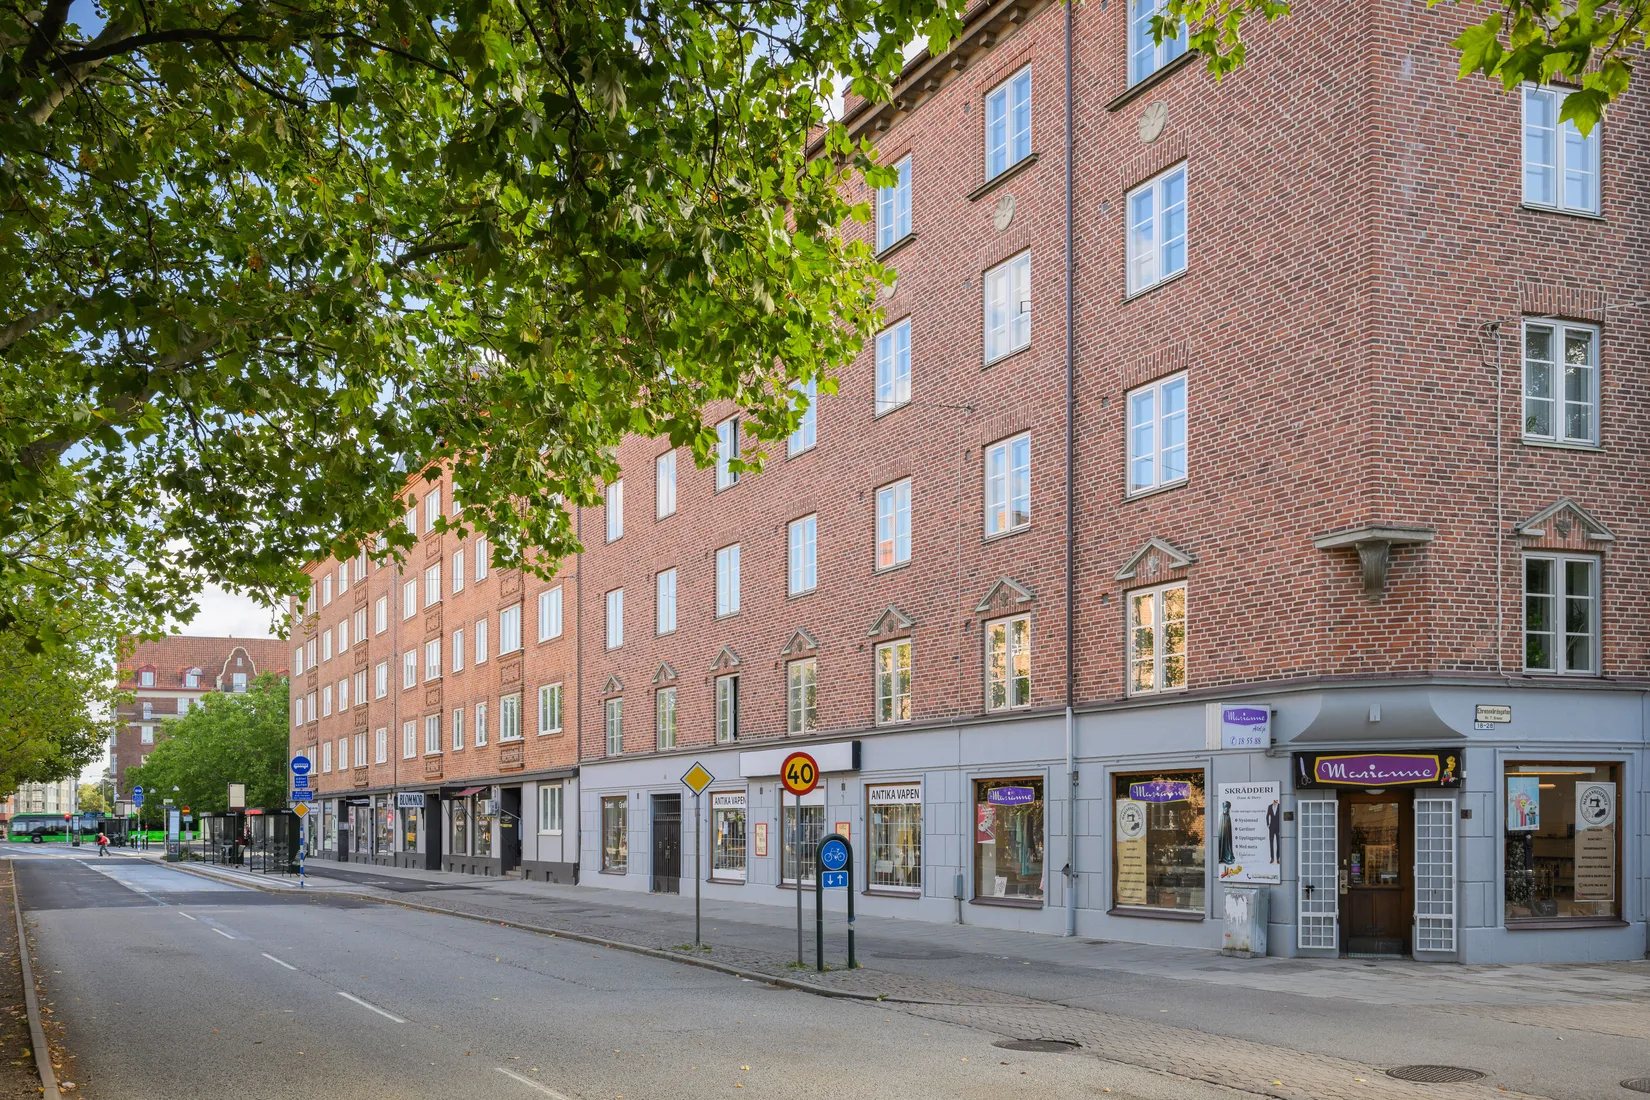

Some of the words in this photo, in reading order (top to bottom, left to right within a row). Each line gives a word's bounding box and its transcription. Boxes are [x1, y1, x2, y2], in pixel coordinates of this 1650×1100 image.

[1226, 711, 1266, 721] Marianne
[1238, 737, 1245, 745] 18
[1246, 737, 1253, 745] 55
[1254, 737, 1262, 745] 88
[787, 763, 813, 784] 40
[1321, 762, 1433, 779] Marianne
[871, 789, 896, 800] ANTIKA
[896, 788, 920, 799] VAPEN
[990, 790, 1032, 801] Marianne
[1132, 785, 1188, 798] Marianne
[1225, 786, 1273, 795] SKRÄDDERI
[399, 794, 423, 806] BLOMMOR
[714, 796, 731, 805] ANTIKA
